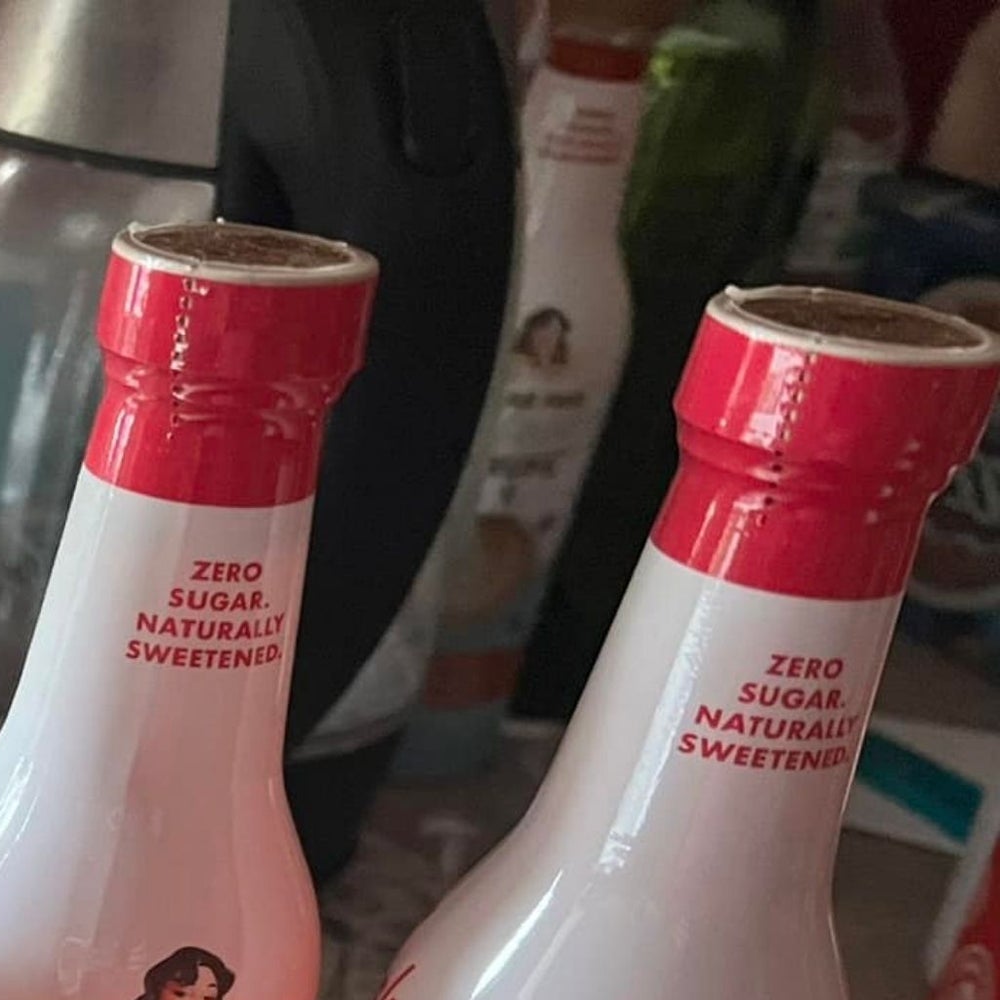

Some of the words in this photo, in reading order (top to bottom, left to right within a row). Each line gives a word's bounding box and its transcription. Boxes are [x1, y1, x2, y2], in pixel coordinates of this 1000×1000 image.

[191, 560, 263, 583] ZERO
[169, 588, 270, 612] SUGAR.
[136, 611, 285, 641] NATURALLY
[125, 640, 283, 669] SWEETENED.
[766, 654, 843, 679] ZERO
[738, 682, 846, 710] SUGAR.
[695, 705, 859, 741] NATURALLY
